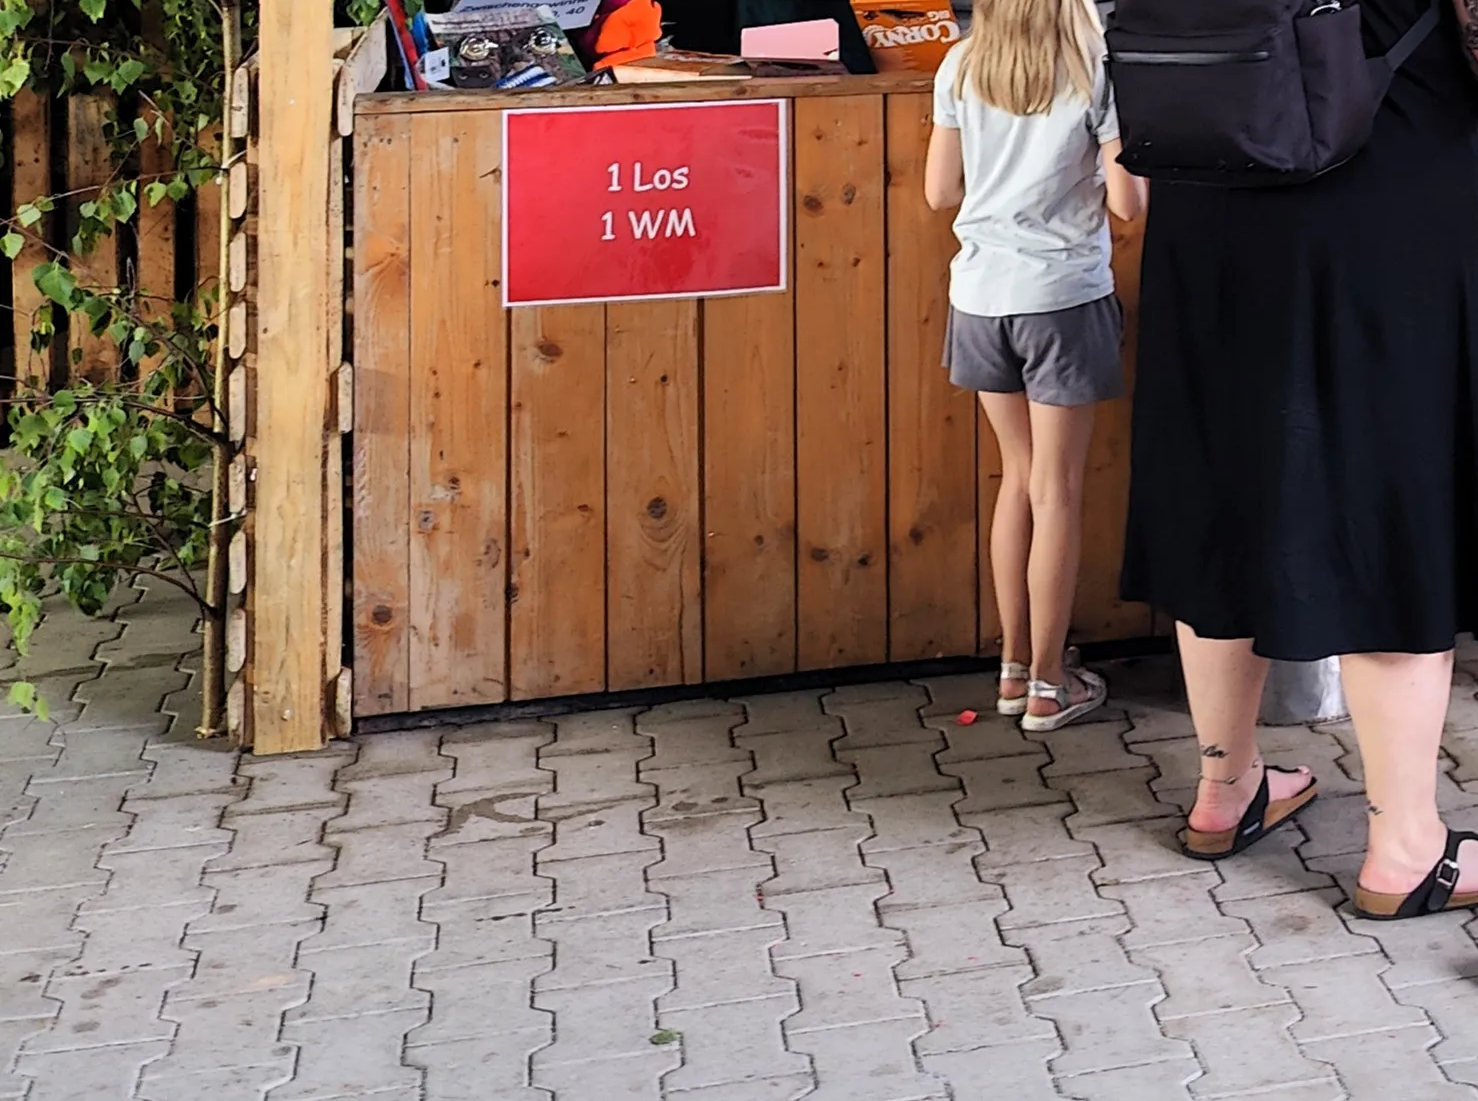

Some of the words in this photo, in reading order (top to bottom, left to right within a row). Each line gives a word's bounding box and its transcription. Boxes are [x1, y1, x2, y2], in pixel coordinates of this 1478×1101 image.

[565, 6, 586, 15] 40
[874, 20, 960, 48] CORNY
[607, 161, 623, 193] 1
[633, 161, 690, 193] Los
[601, 210, 617, 241] 1
[627, 207, 697, 240] WM
